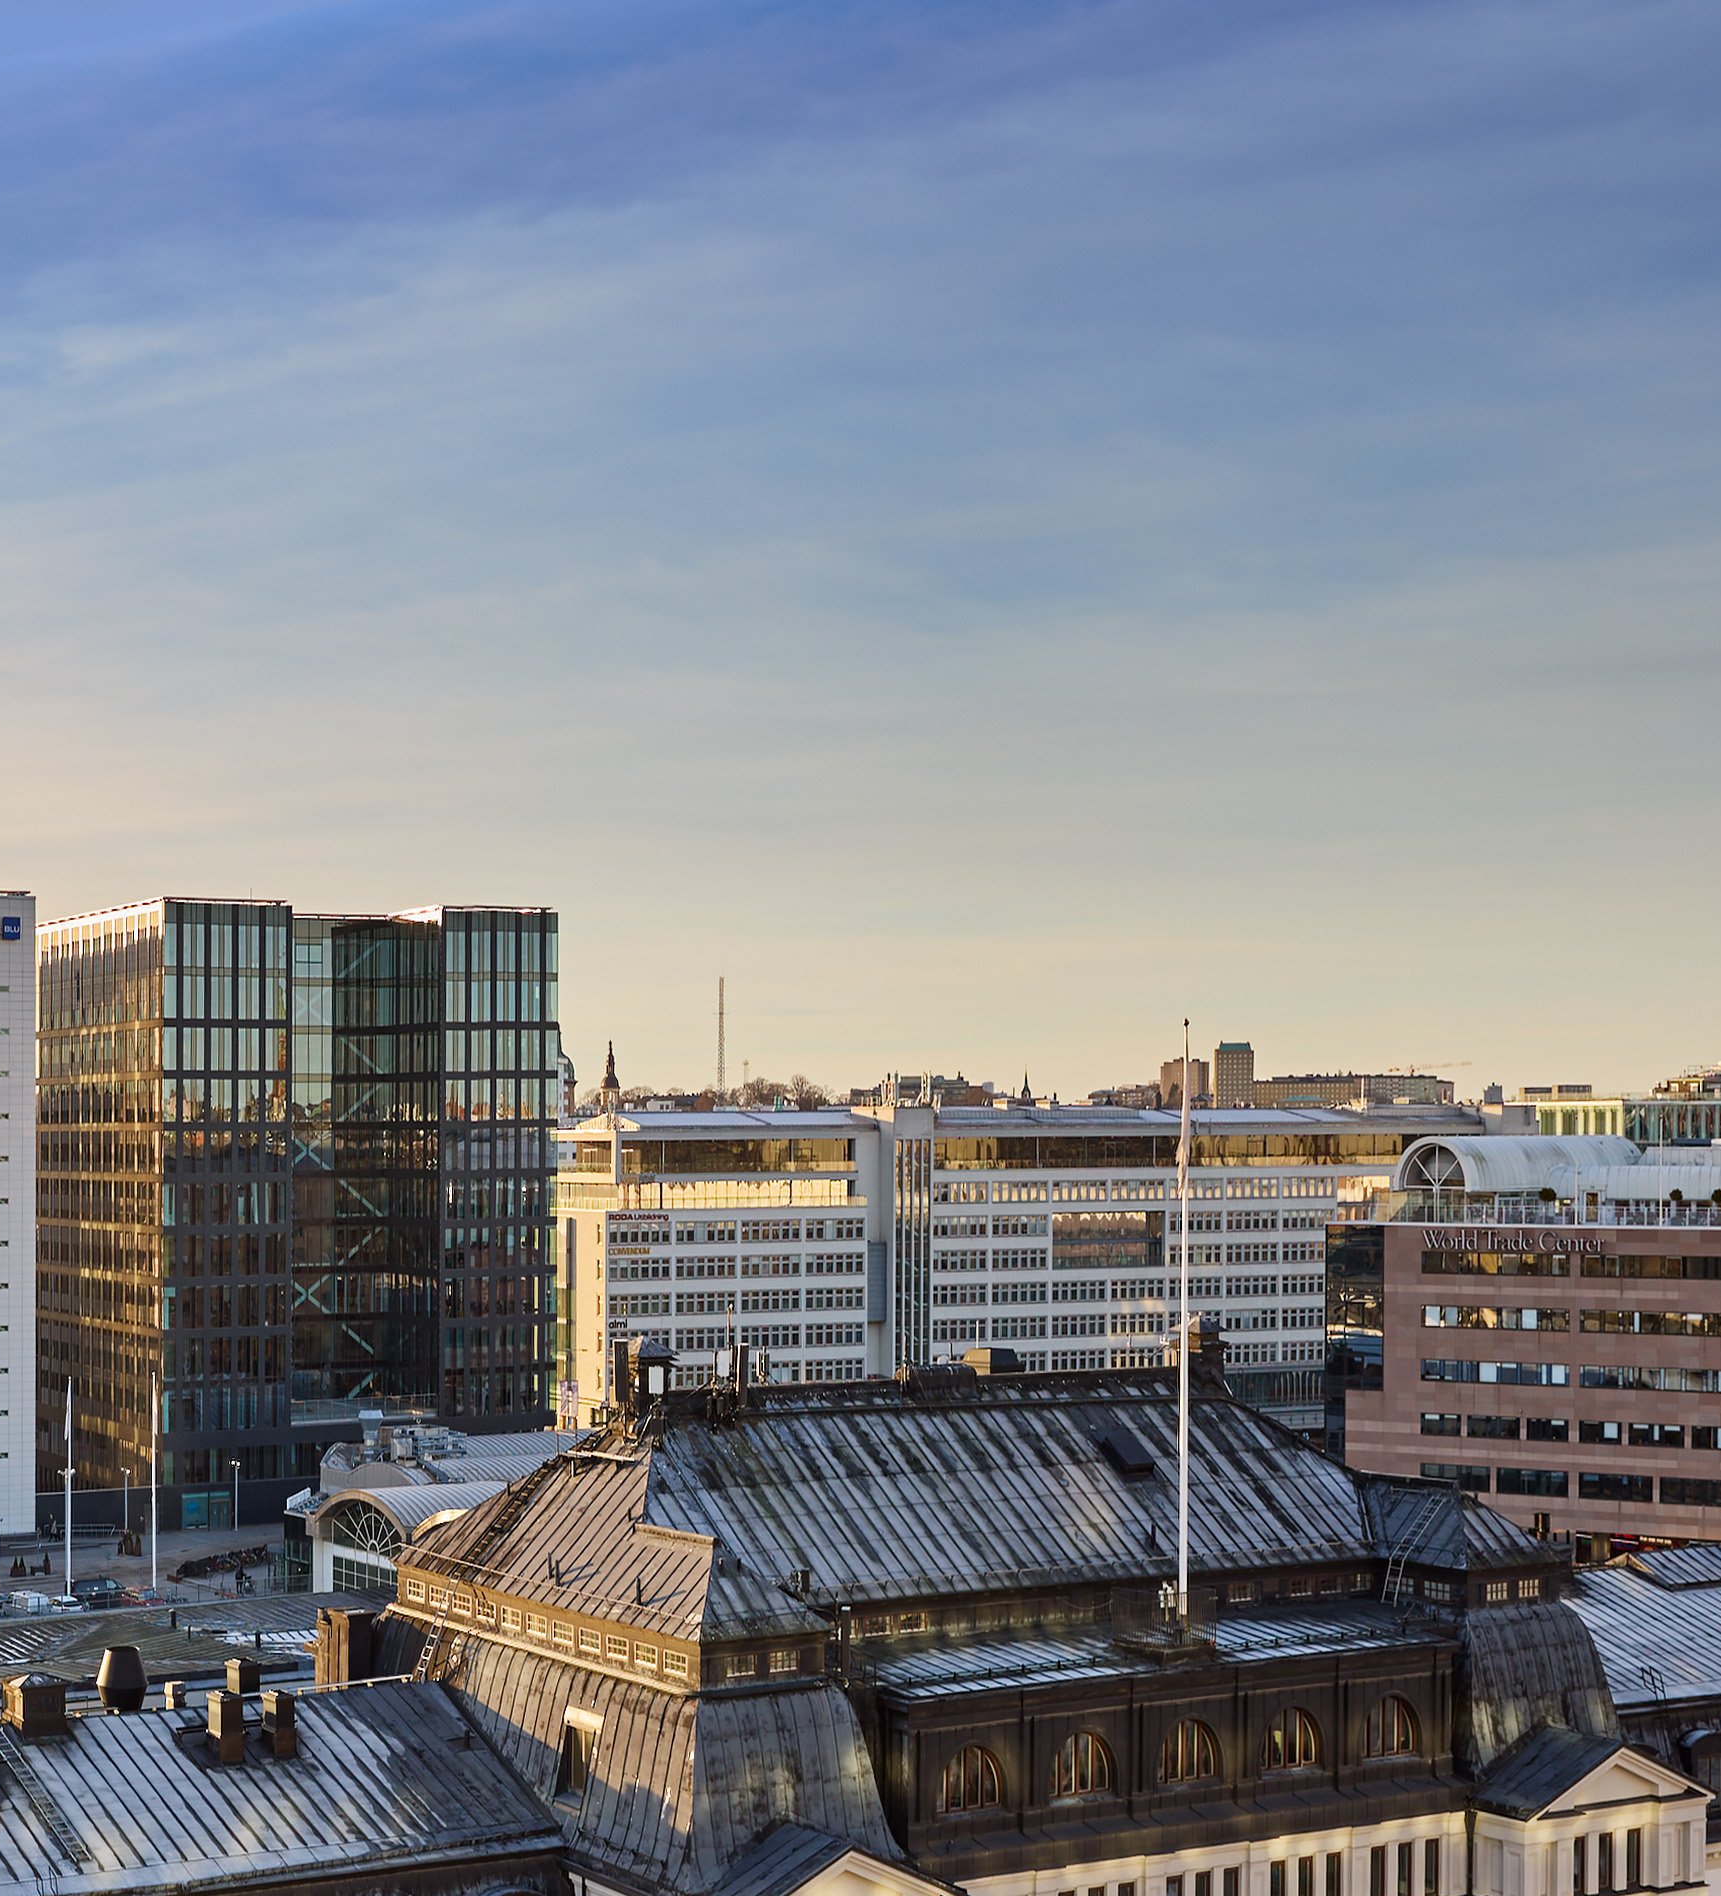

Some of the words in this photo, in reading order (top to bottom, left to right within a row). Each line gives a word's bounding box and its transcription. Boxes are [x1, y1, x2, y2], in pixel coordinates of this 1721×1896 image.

[4, 925, 20, 934] BLU
[1423, 1228, 1478, 1251] World
[1483, 1229, 1534, 1252] Trade
[1538, 1230, 1605, 1254] Center
